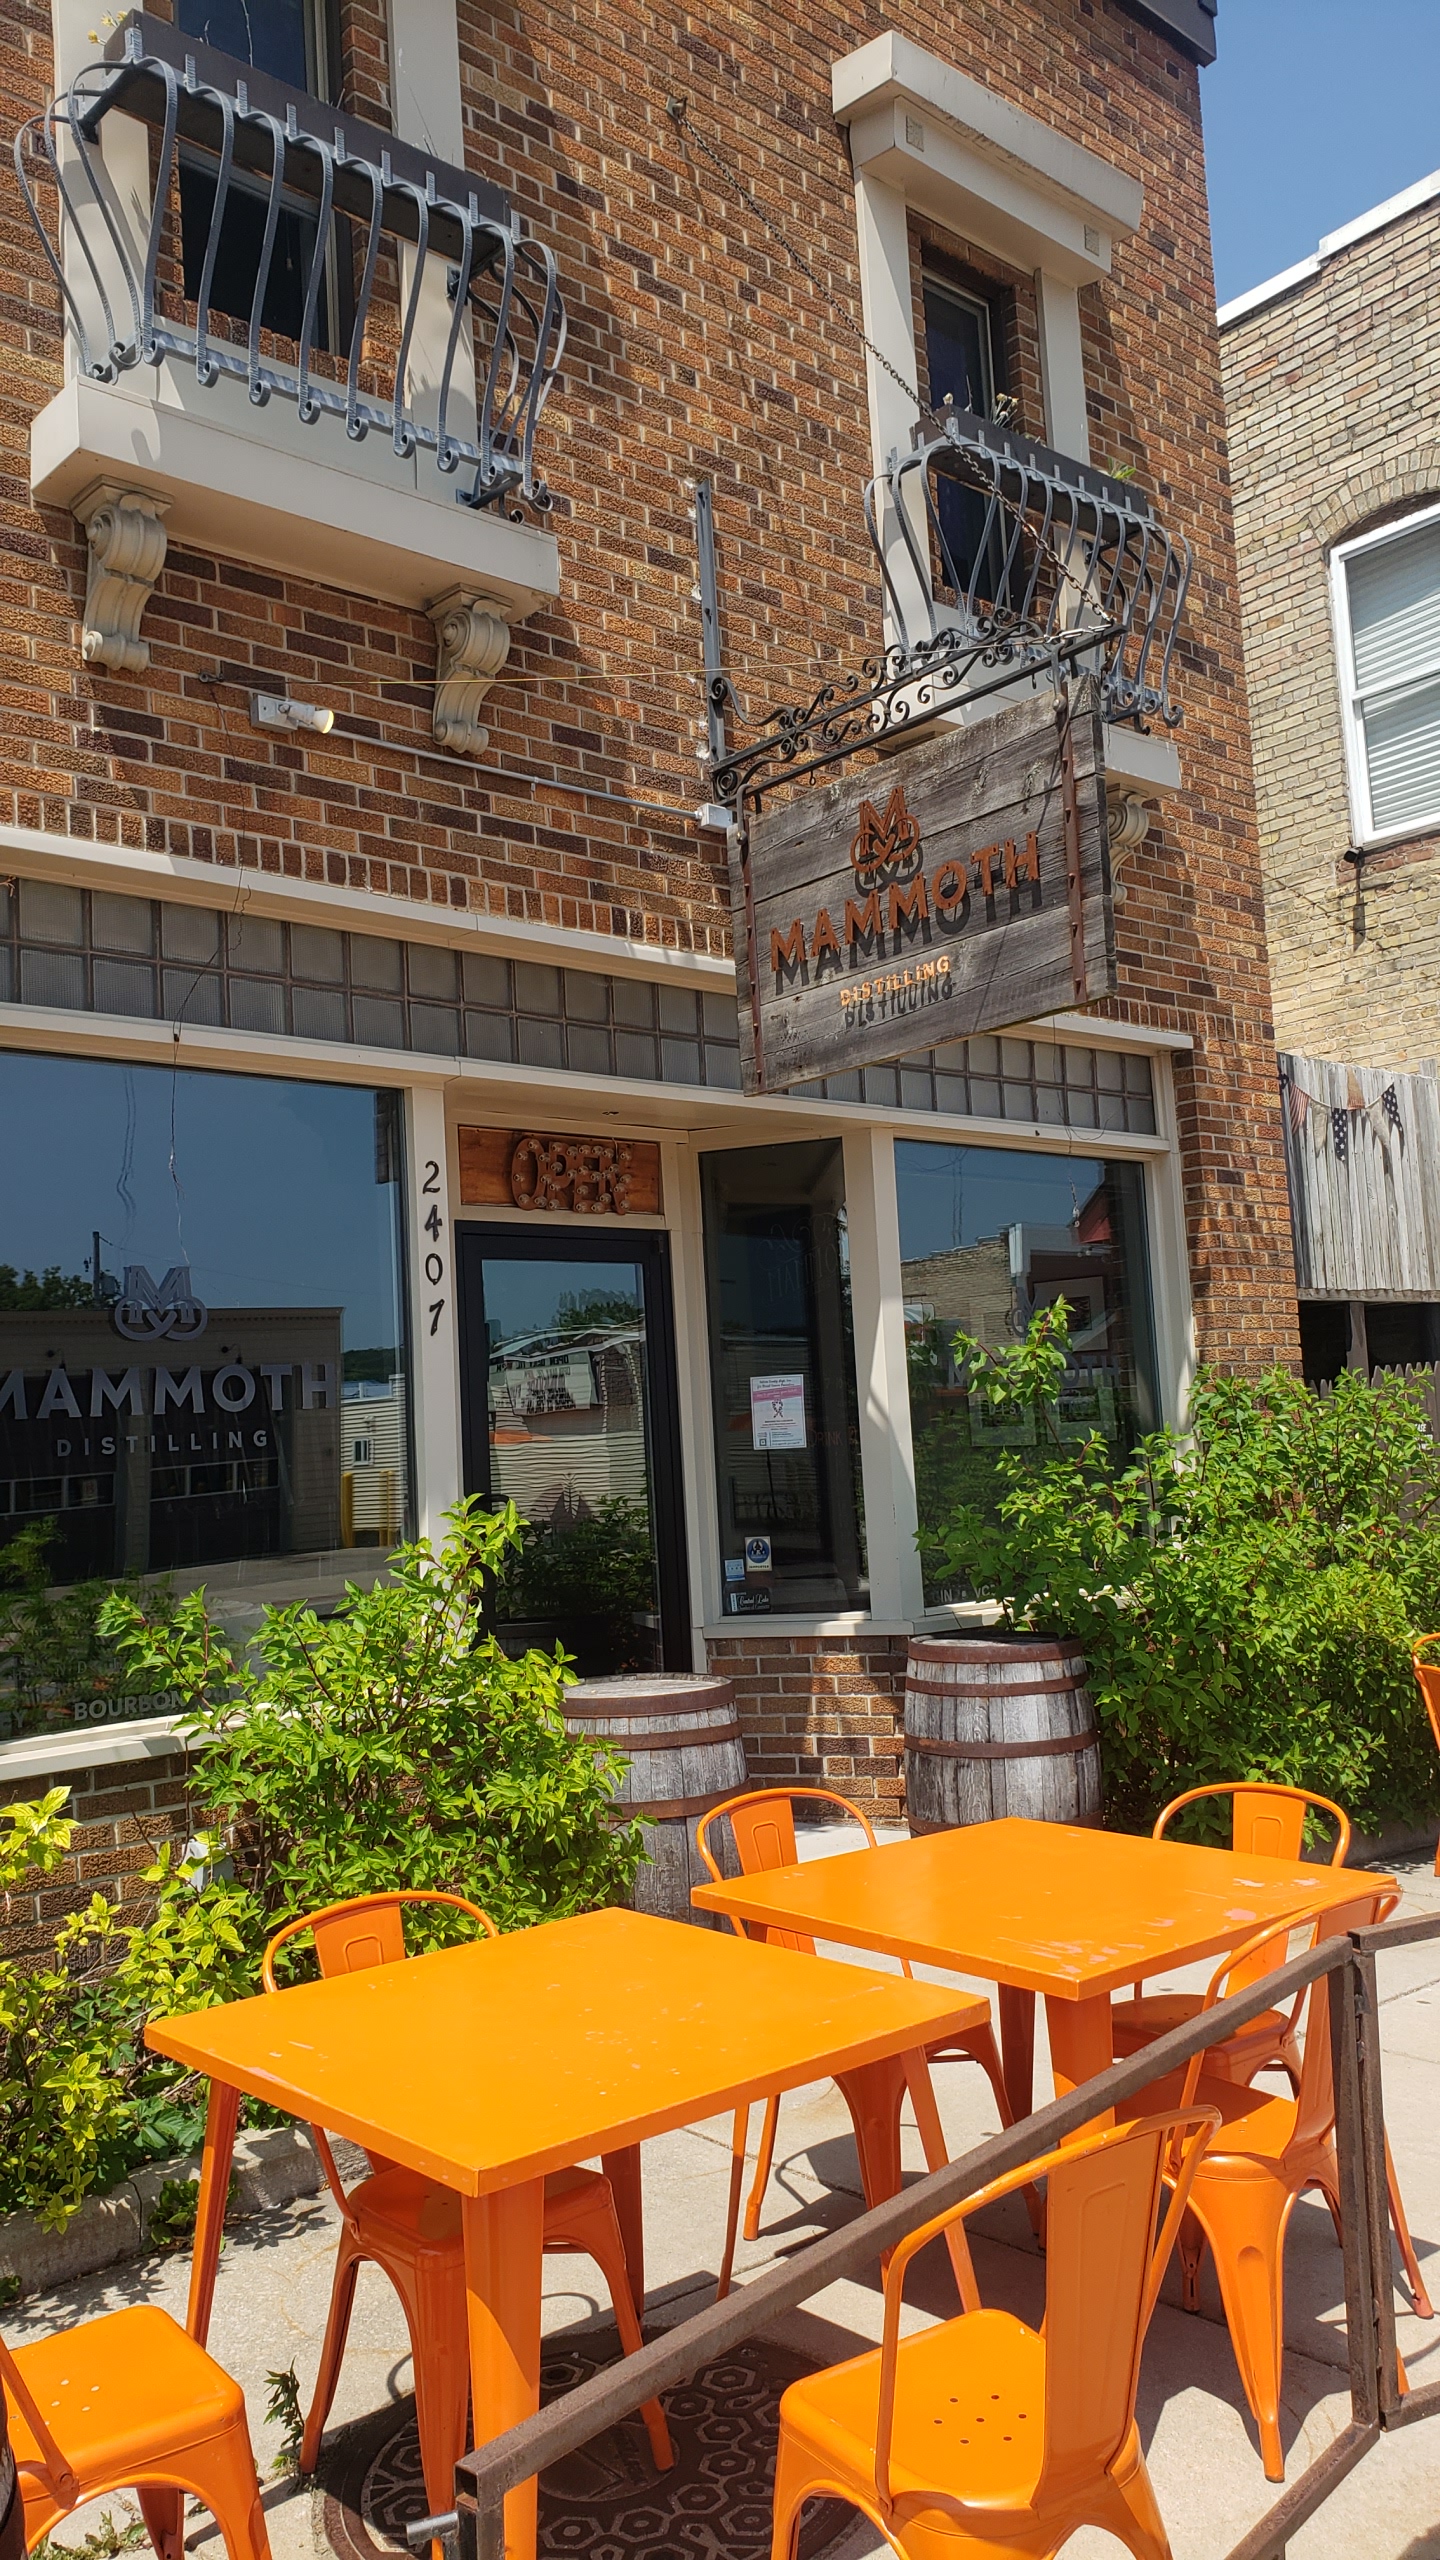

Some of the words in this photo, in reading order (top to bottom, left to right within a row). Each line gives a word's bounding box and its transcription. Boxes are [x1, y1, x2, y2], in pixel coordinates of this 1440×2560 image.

[769, 830, 1041, 973] MAMMOTH
[839, 954, 951, 1007] DISTILLING
[512, 1138, 632, 1215] OPEN
[422, 1160, 446, 1337] 2407
[57, 1429, 268, 1457] DISTILLING
[74, 1689, 187, 1721] BOURBON
